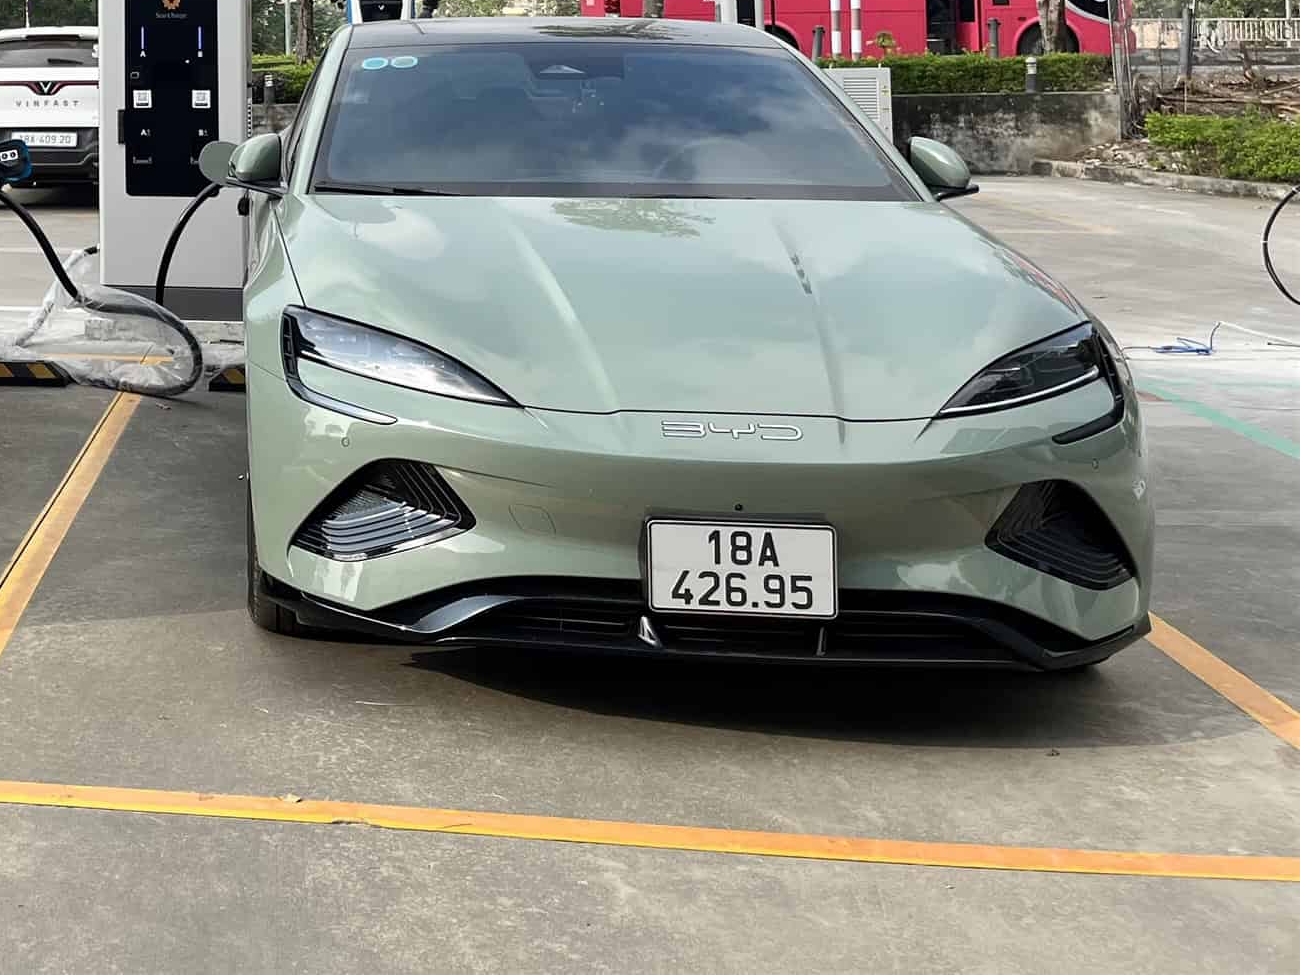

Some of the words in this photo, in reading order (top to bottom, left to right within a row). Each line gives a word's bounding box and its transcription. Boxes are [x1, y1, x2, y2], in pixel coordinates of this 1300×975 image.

[15, 99, 81, 108] VINFAST
[661, 420, 804, 441] BYD
[708, 530, 779, 567] 18A
[671, 570, 813, 610] 426.95
